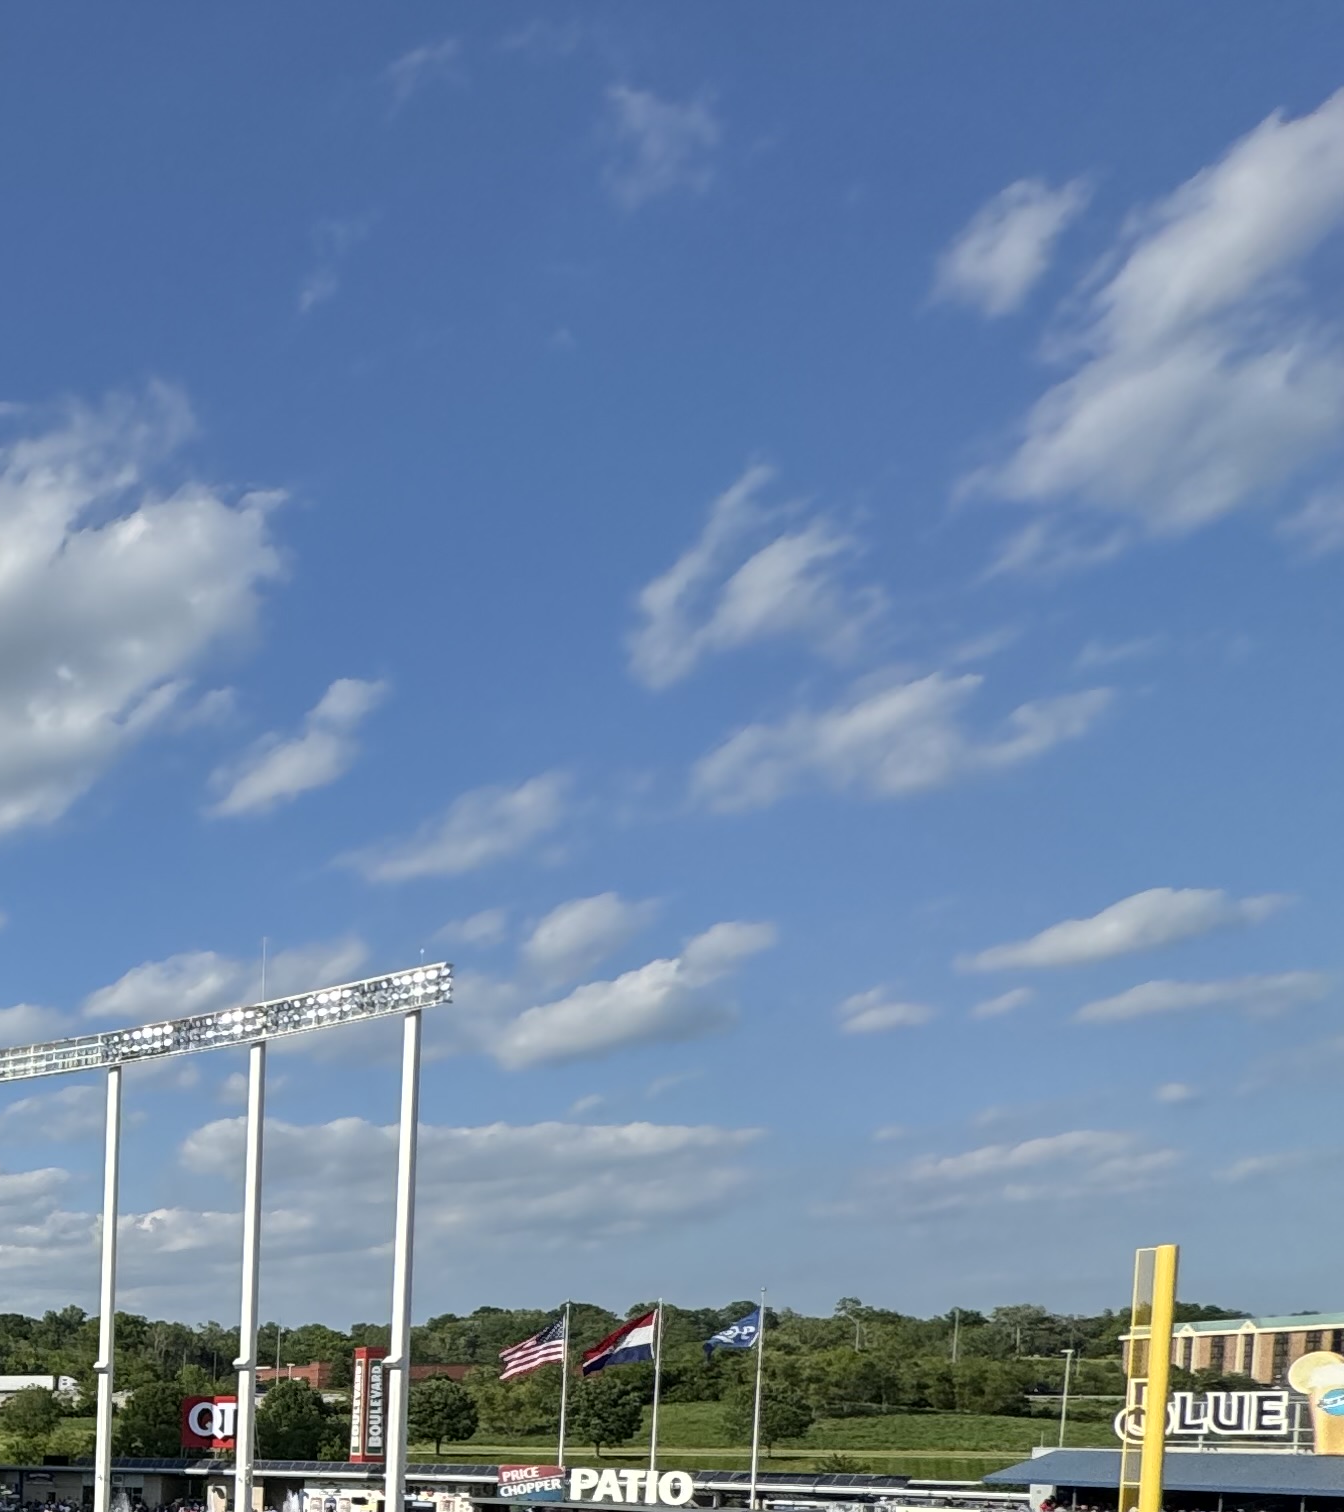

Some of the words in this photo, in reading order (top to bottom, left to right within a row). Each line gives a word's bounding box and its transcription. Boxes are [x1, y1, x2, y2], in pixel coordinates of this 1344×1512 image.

[189, 1402, 237, 1440] QT
[369, 1365, 383, 1447] BOULEVARD
[499, 1478, 562, 1498] CHOPPER
[502, 1467, 540, 1482] PRICE
[570, 1468, 694, 1505] PATIO
